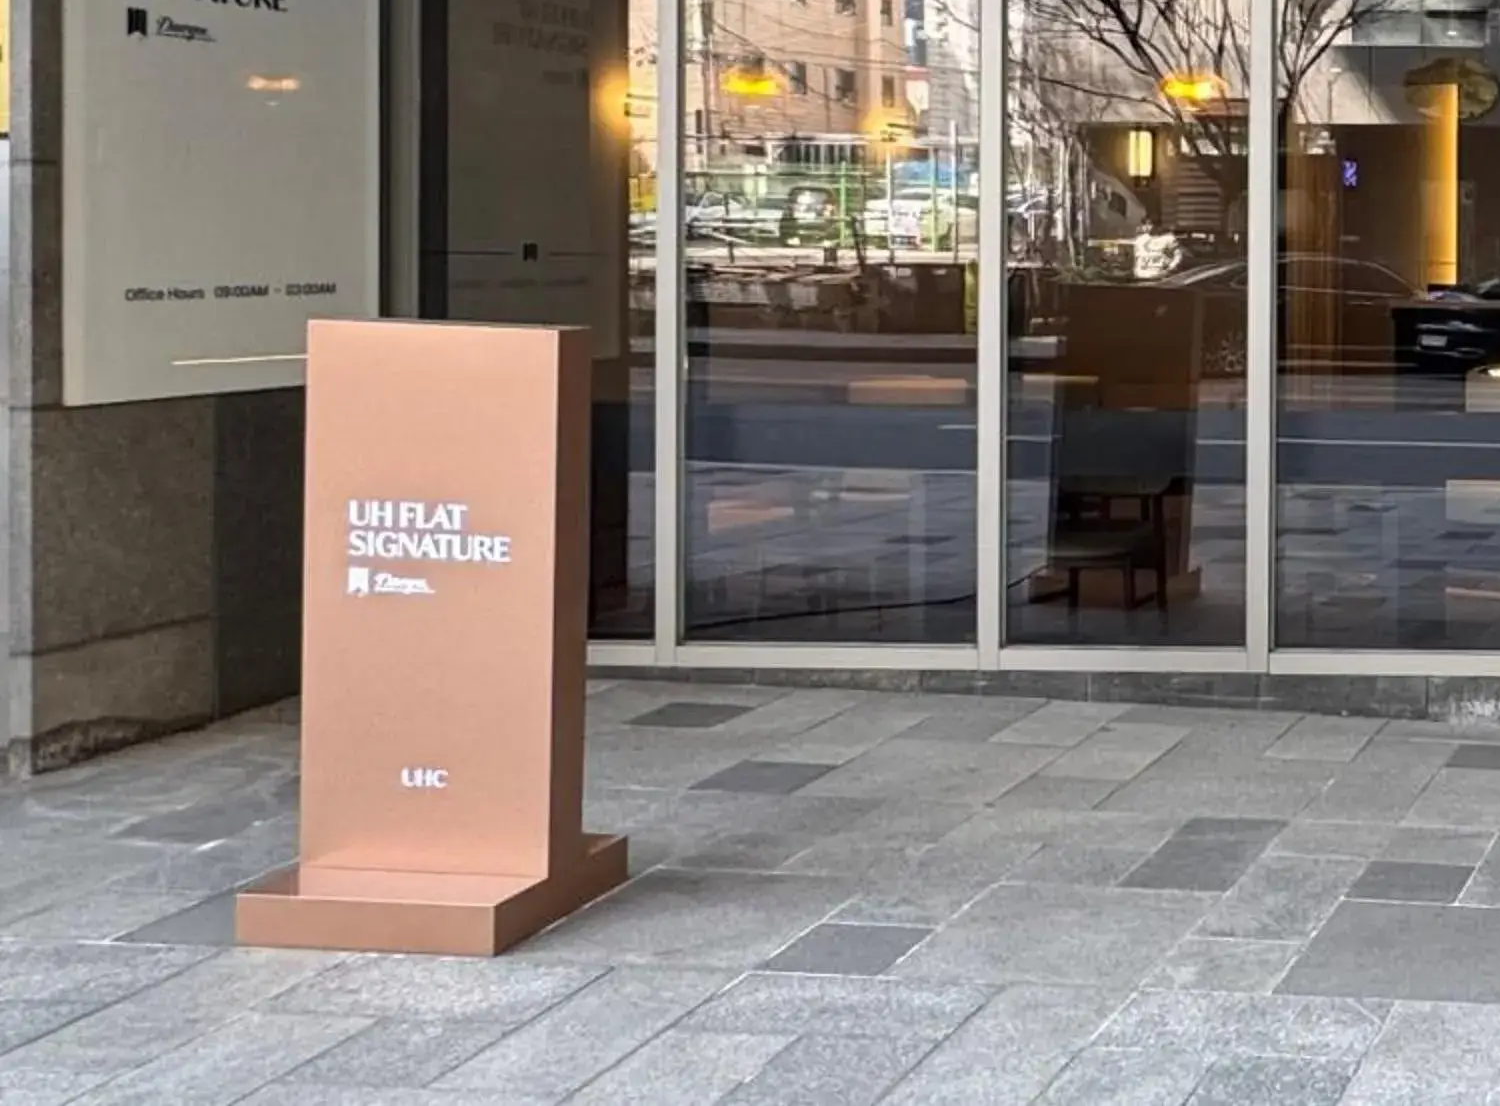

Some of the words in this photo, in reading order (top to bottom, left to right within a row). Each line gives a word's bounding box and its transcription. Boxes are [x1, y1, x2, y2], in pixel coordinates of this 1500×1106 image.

[125, 287, 164, 301] Office
[348, 499, 393, 529] UH
[399, 501, 468, 531] FLAT
[347, 531, 512, 563] SIGNATURE
